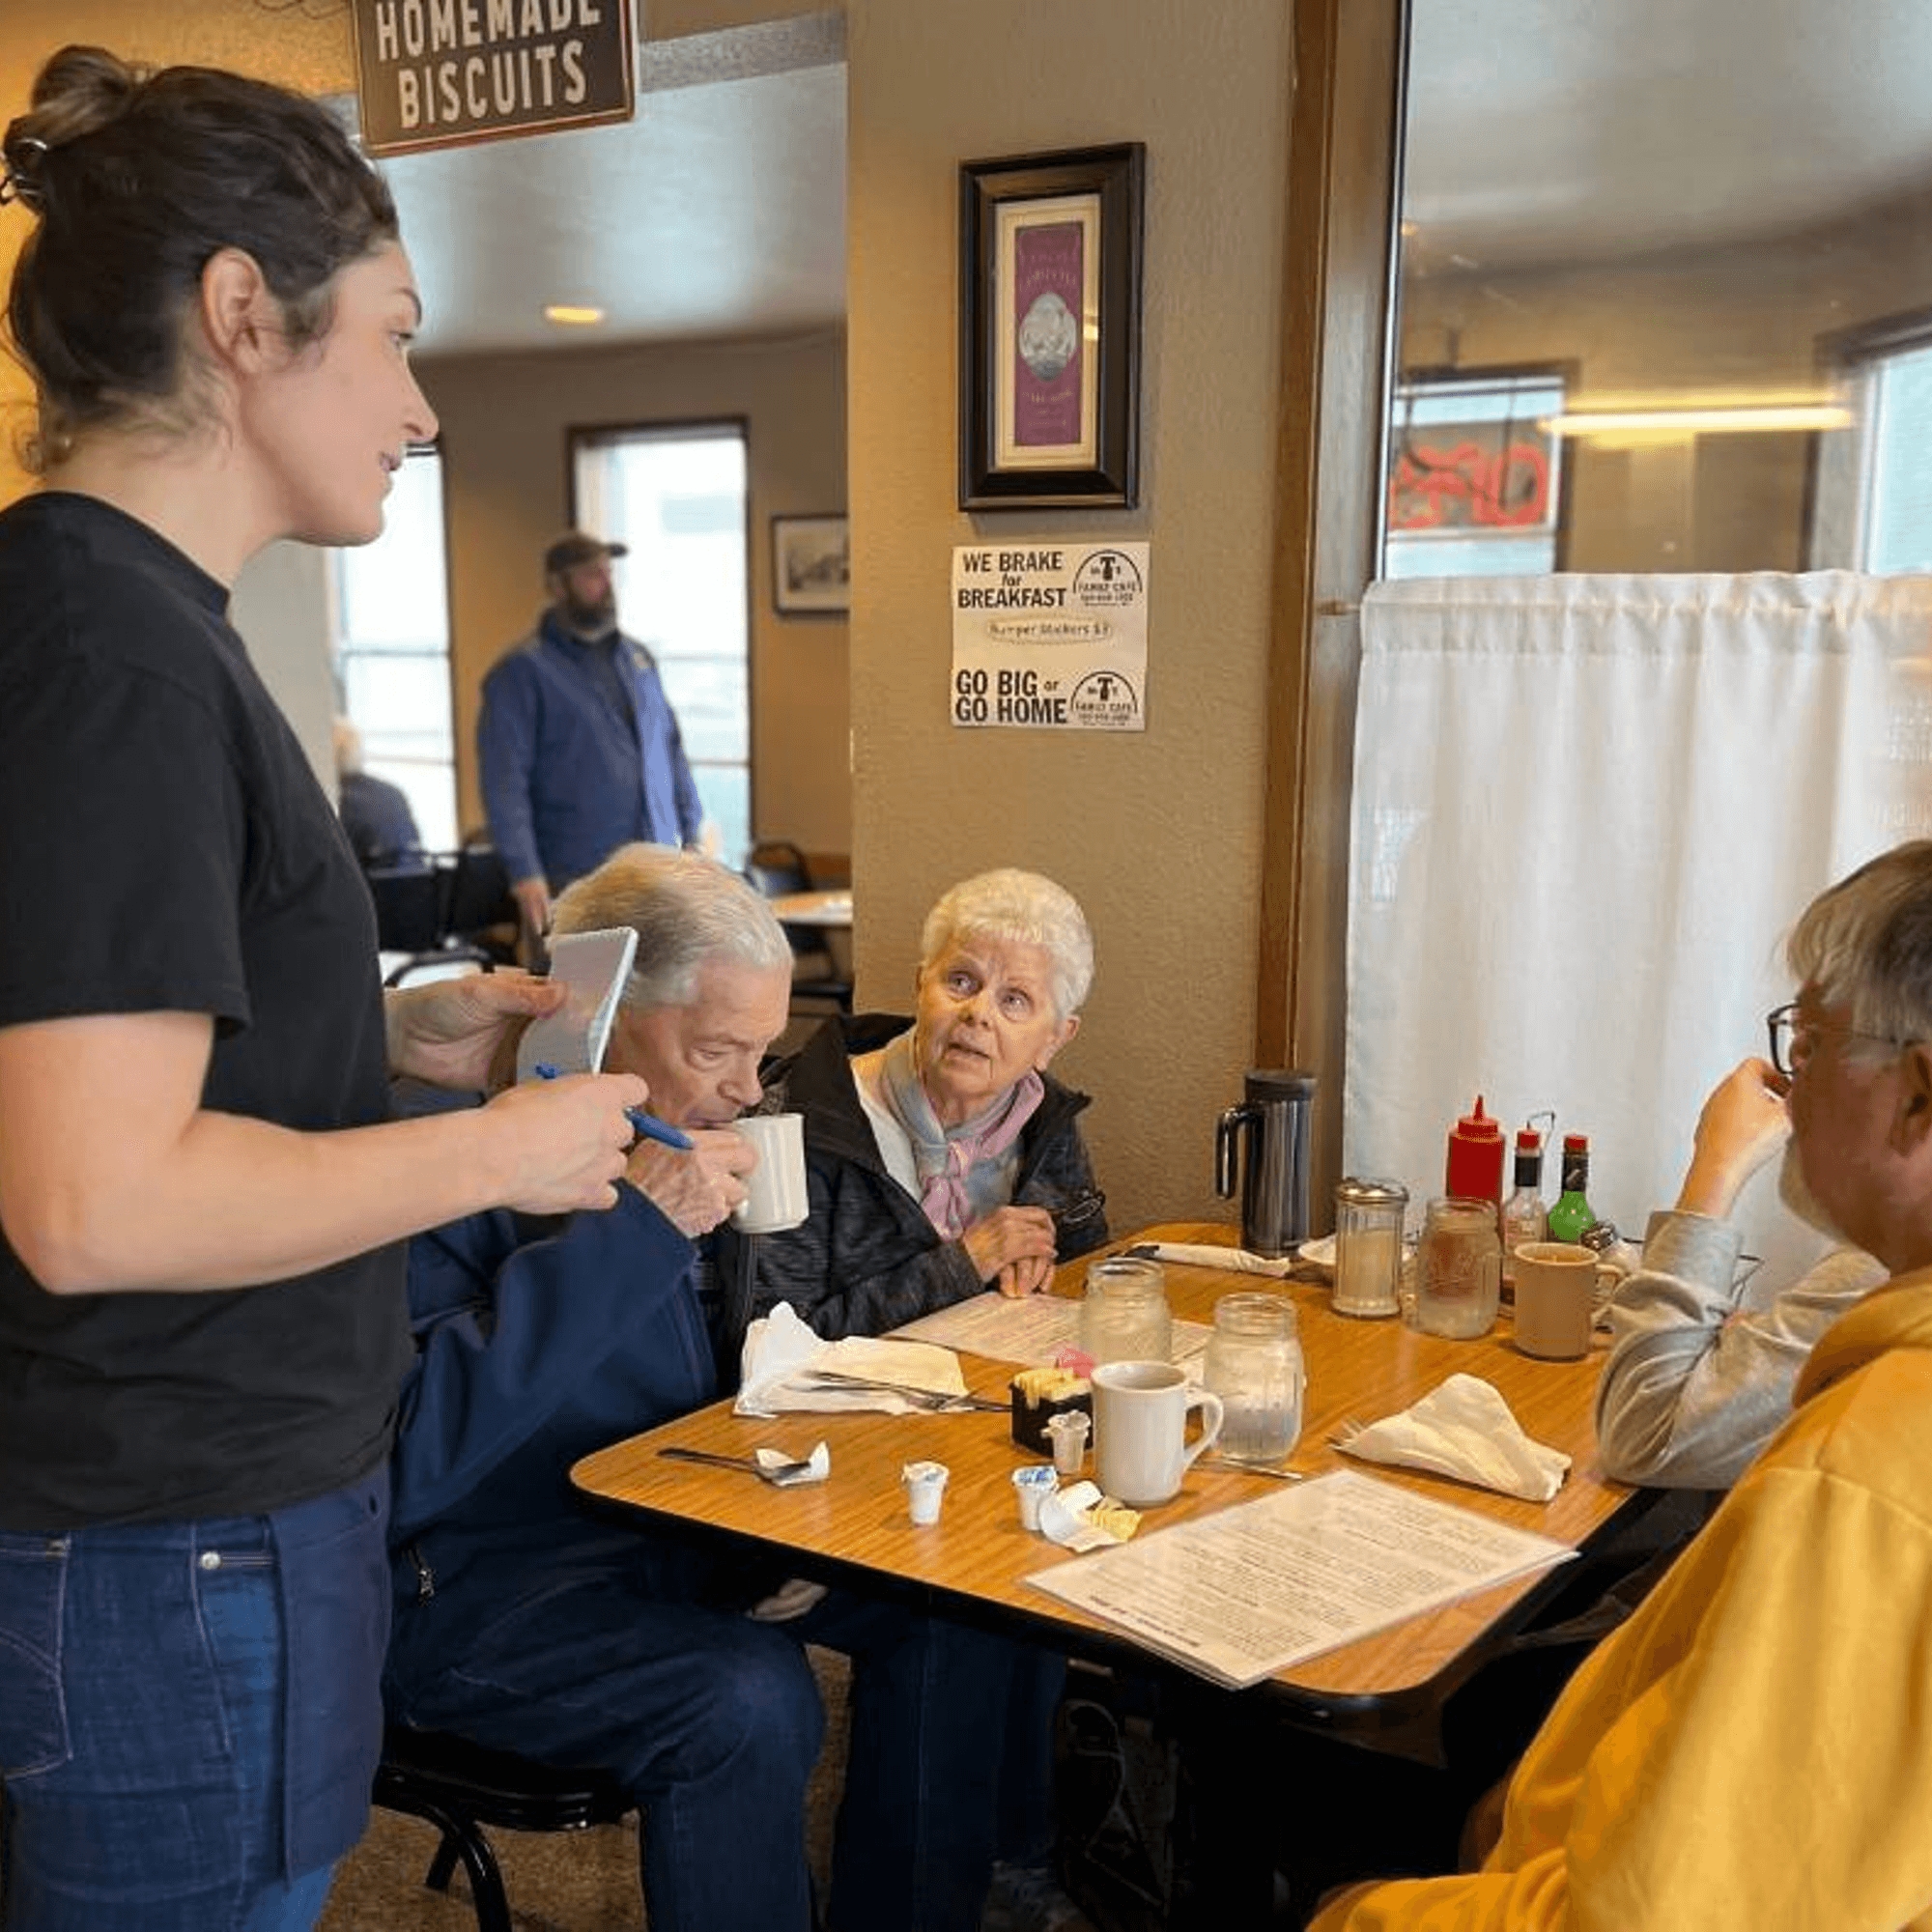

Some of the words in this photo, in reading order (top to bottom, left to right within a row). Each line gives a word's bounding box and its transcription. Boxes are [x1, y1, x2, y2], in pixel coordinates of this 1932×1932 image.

[398, 40, 587, 128] BISCUITS
[962, 553, 992, 573] WE
[999, 551, 1064, 572] BRAKE
[1002, 573, 1022, 586] for
[957, 587, 1067, 609] BREAKFAST
[956, 668, 988, 695] GO
[998, 669, 1037, 696] BIG
[1043, 680, 1060, 692] or
[955, 696, 988, 722] GO
[997, 697, 1067, 724] HOME
